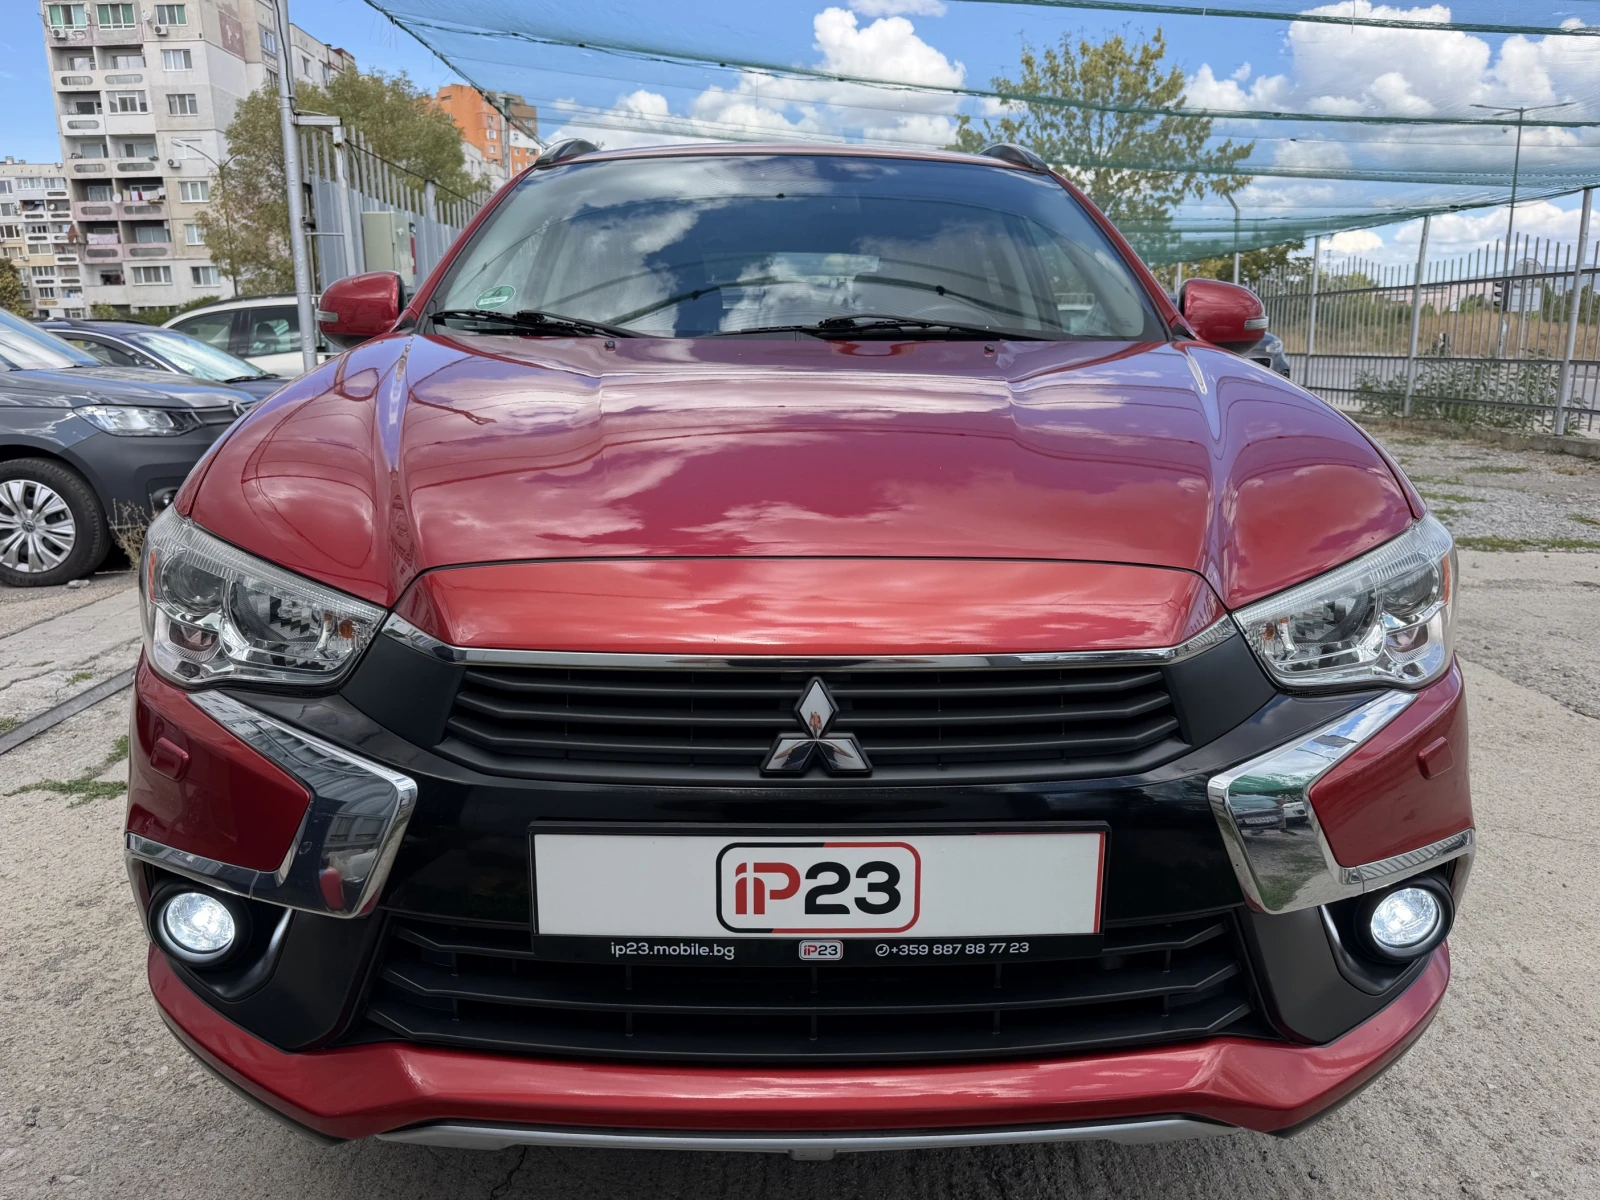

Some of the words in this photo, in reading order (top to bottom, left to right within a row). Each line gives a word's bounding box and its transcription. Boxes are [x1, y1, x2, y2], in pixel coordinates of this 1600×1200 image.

[610, 942, 735, 960] ip23.mobile.bg
[890, 944, 929, 956] +359
[932, 943, 963, 955] 887
[965, 943, 986, 955] 88
[988, 942, 1007, 954] 77
[1009, 942, 1030, 954] 23
